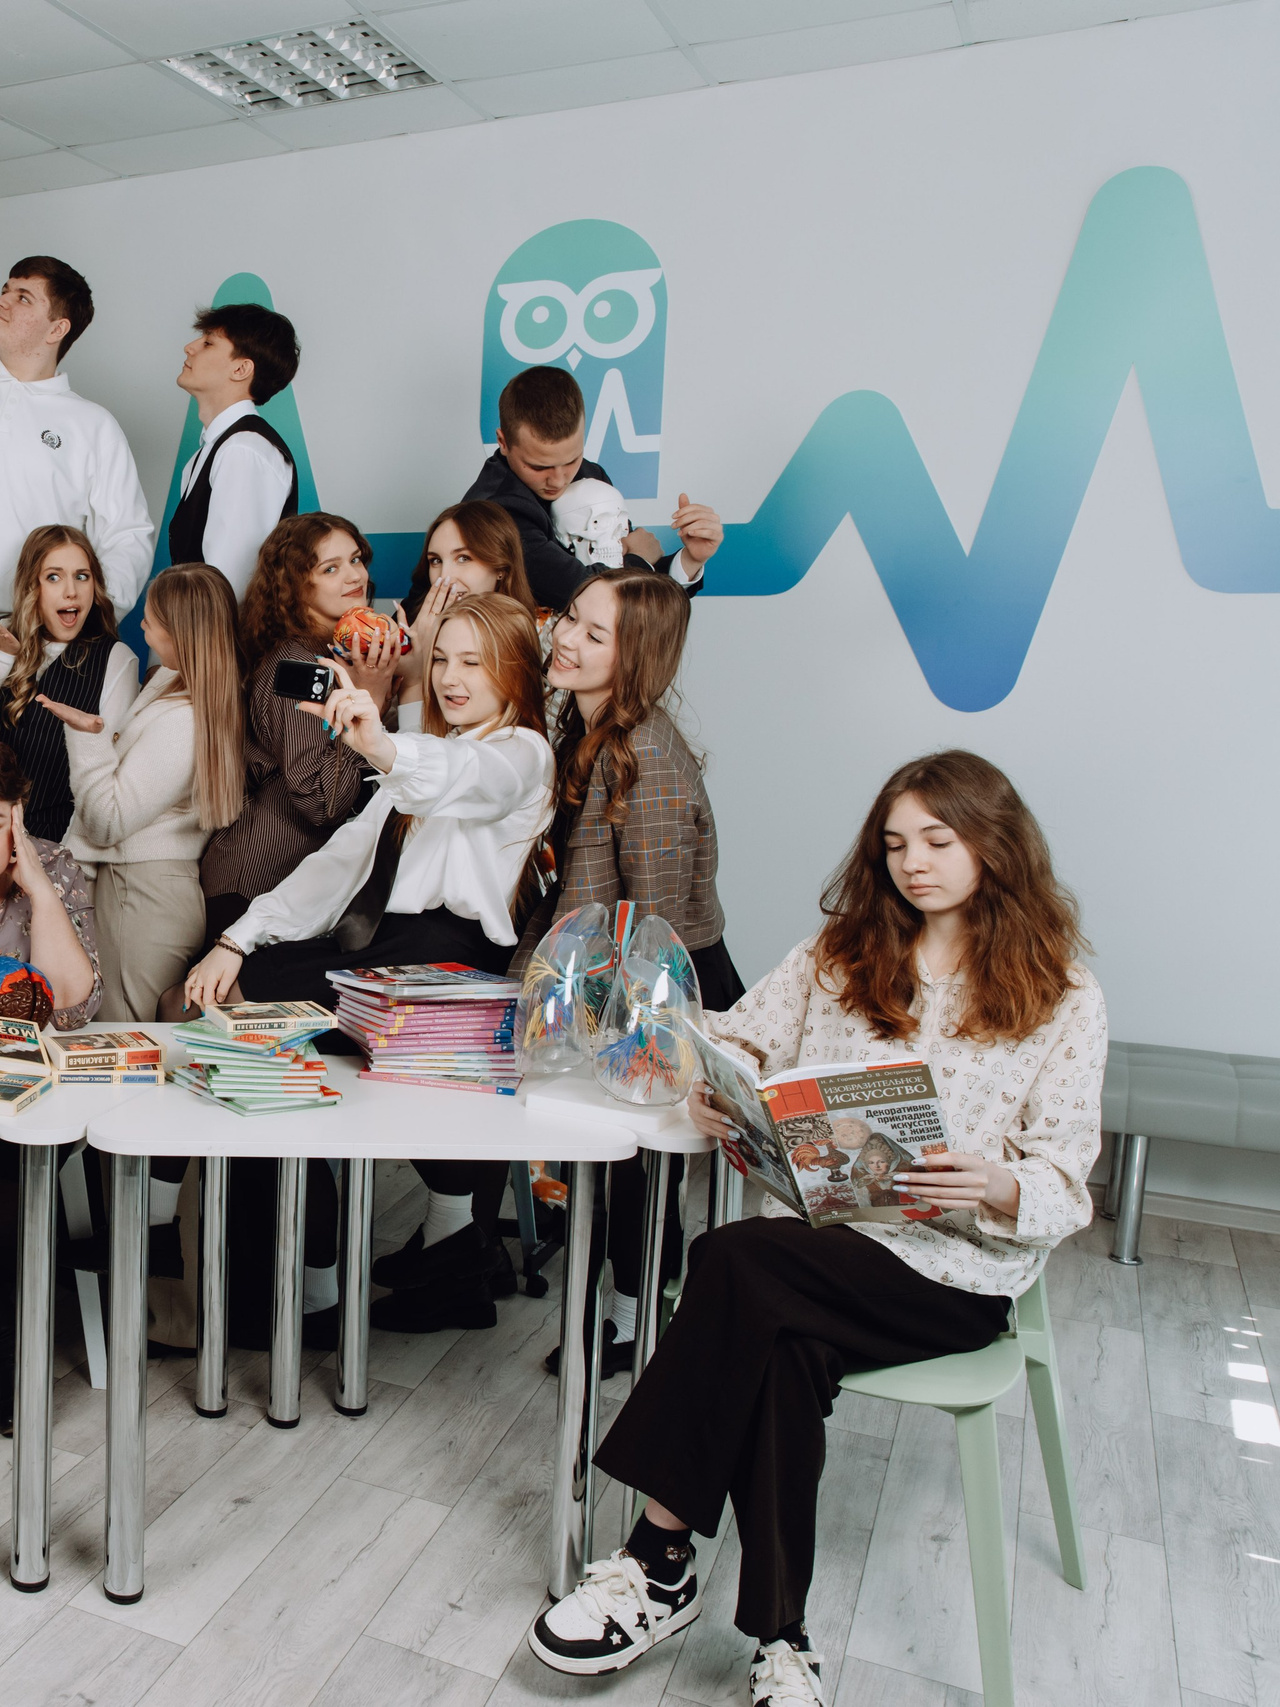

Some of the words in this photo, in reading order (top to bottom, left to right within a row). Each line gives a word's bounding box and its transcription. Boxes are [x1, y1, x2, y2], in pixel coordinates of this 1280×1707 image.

[824, 1075, 924, 1095] ИЗОБРАЗИТЕЛЬНОЕ
[826, 1084, 927, 1105] ИСКУССТВО
[865, 1103, 935, 1119] Декоративно-
[877, 1111, 938, 1125] прикладное
[891, 1118, 940, 1131] искусство
[909, 1125, 942, 1135] жизни
[896, 1132, 945, 1144] человека
